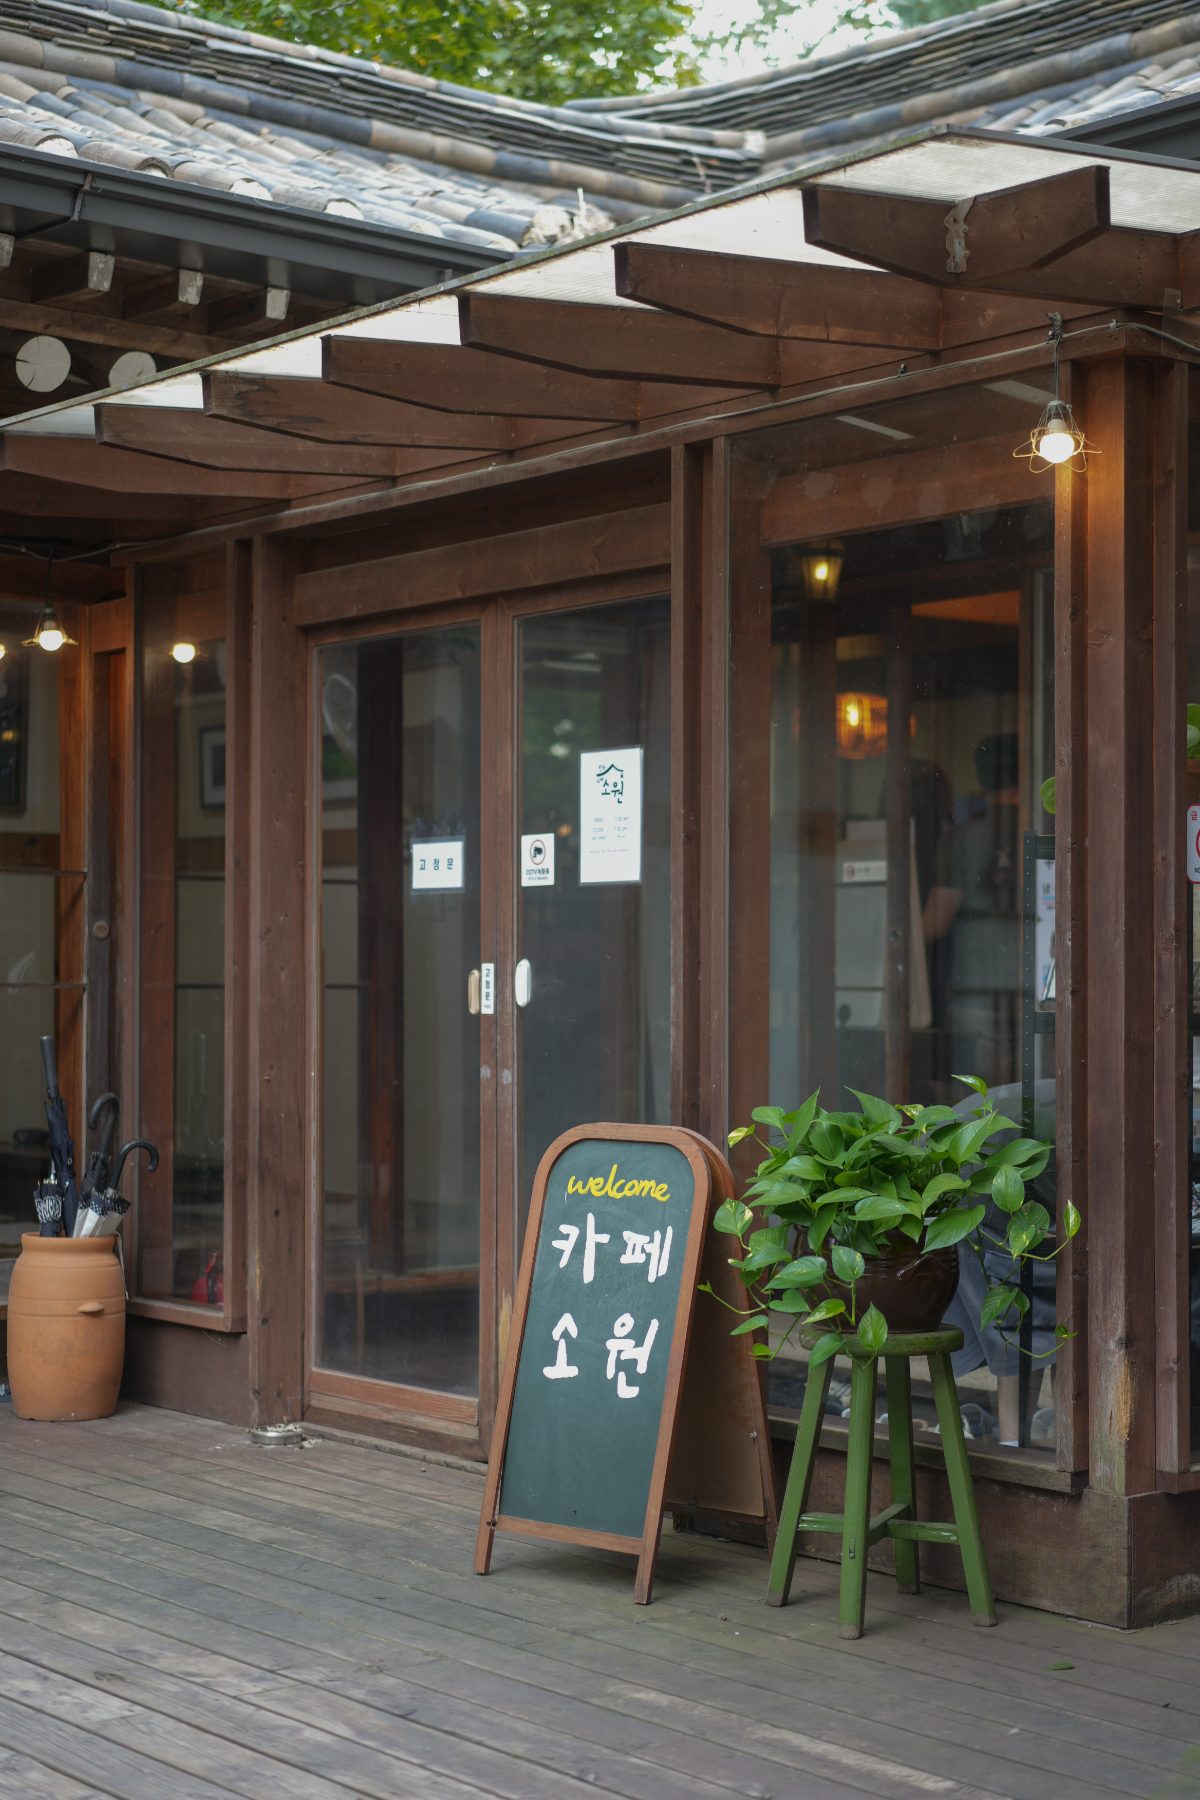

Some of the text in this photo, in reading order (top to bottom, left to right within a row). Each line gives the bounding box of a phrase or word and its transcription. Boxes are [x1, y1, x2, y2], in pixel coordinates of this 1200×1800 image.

[601, 778, 624, 804] 소원
[567, 1163, 671, 1202] welcome
[551, 1212, 673, 1285] 카페
[542, 1312, 659, 1399] 소원
